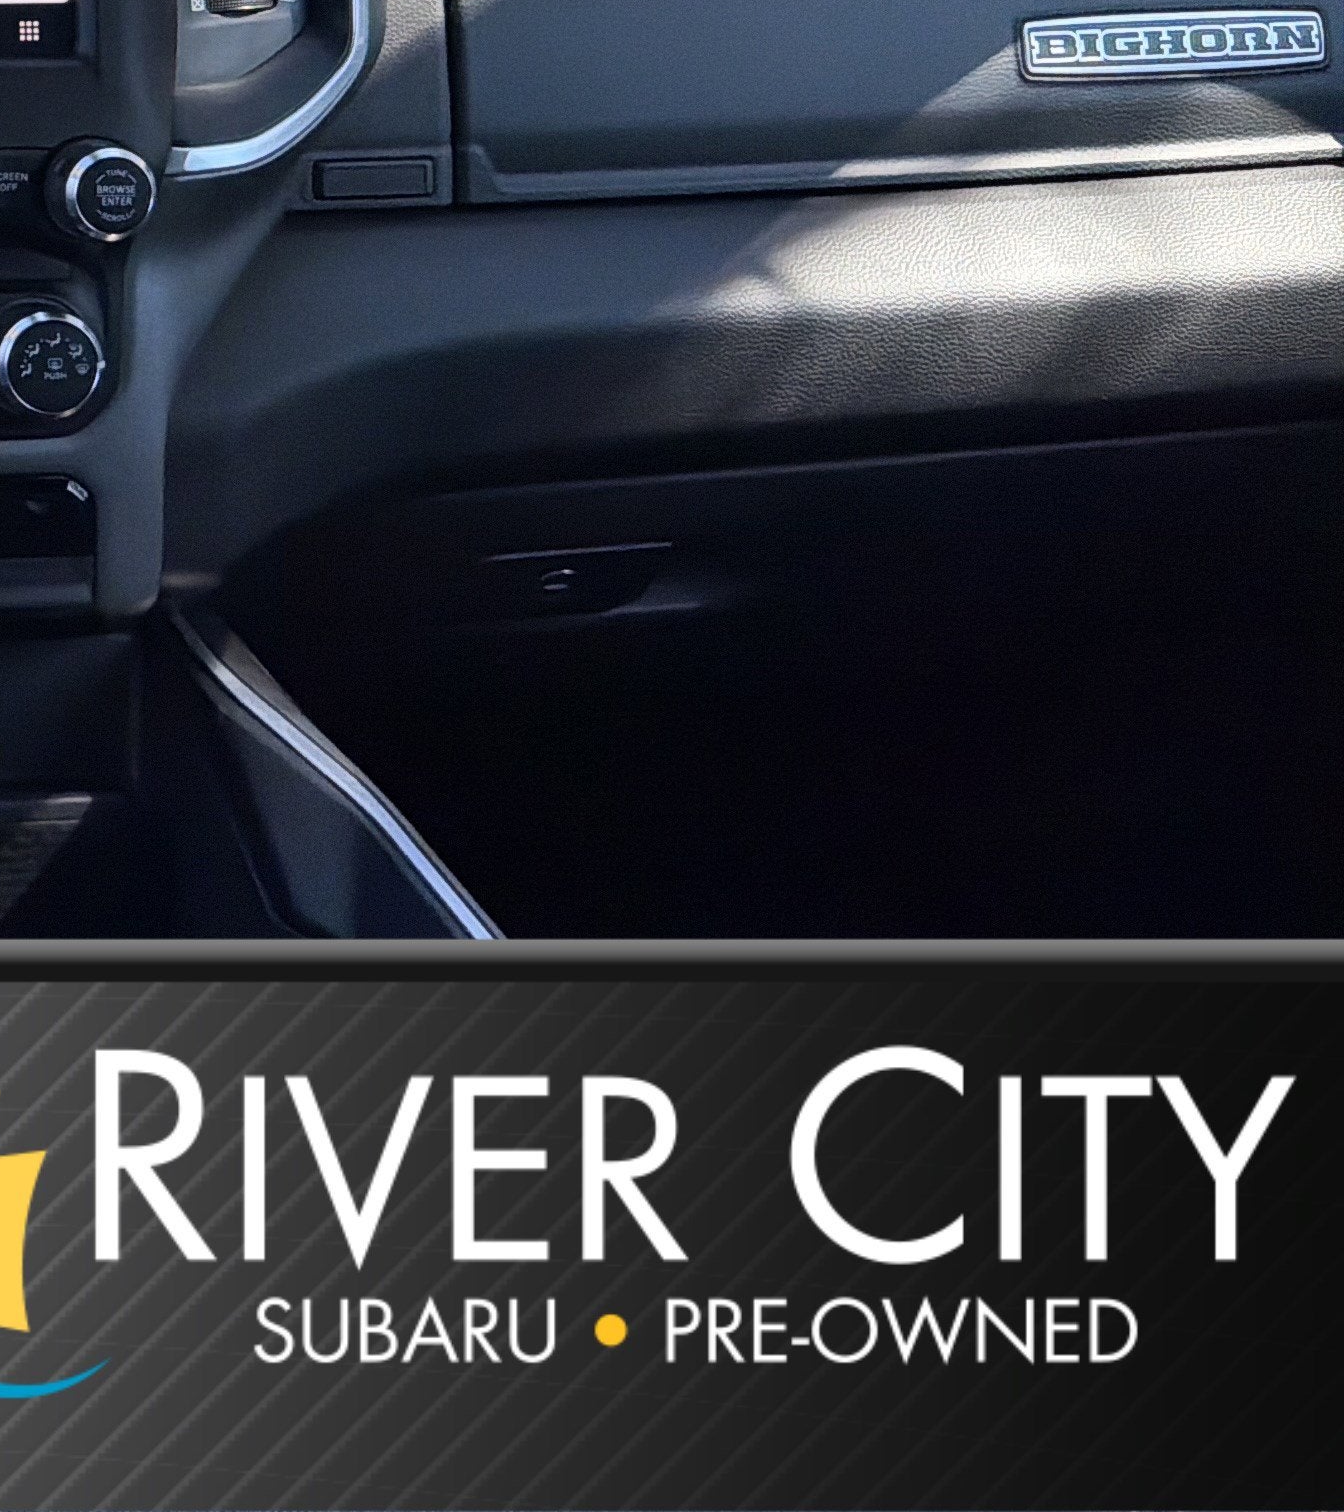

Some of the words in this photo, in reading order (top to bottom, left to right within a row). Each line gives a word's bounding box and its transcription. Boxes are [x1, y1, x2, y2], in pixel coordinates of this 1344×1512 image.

[1030, 21, 1318, 63] BIGHORN
[0, 182, 18, 192] OFF
[96, 184, 136, 195] BROWSE
[101, 195, 133, 206] ENTER
[43, 371, 68, 381] PUSH
